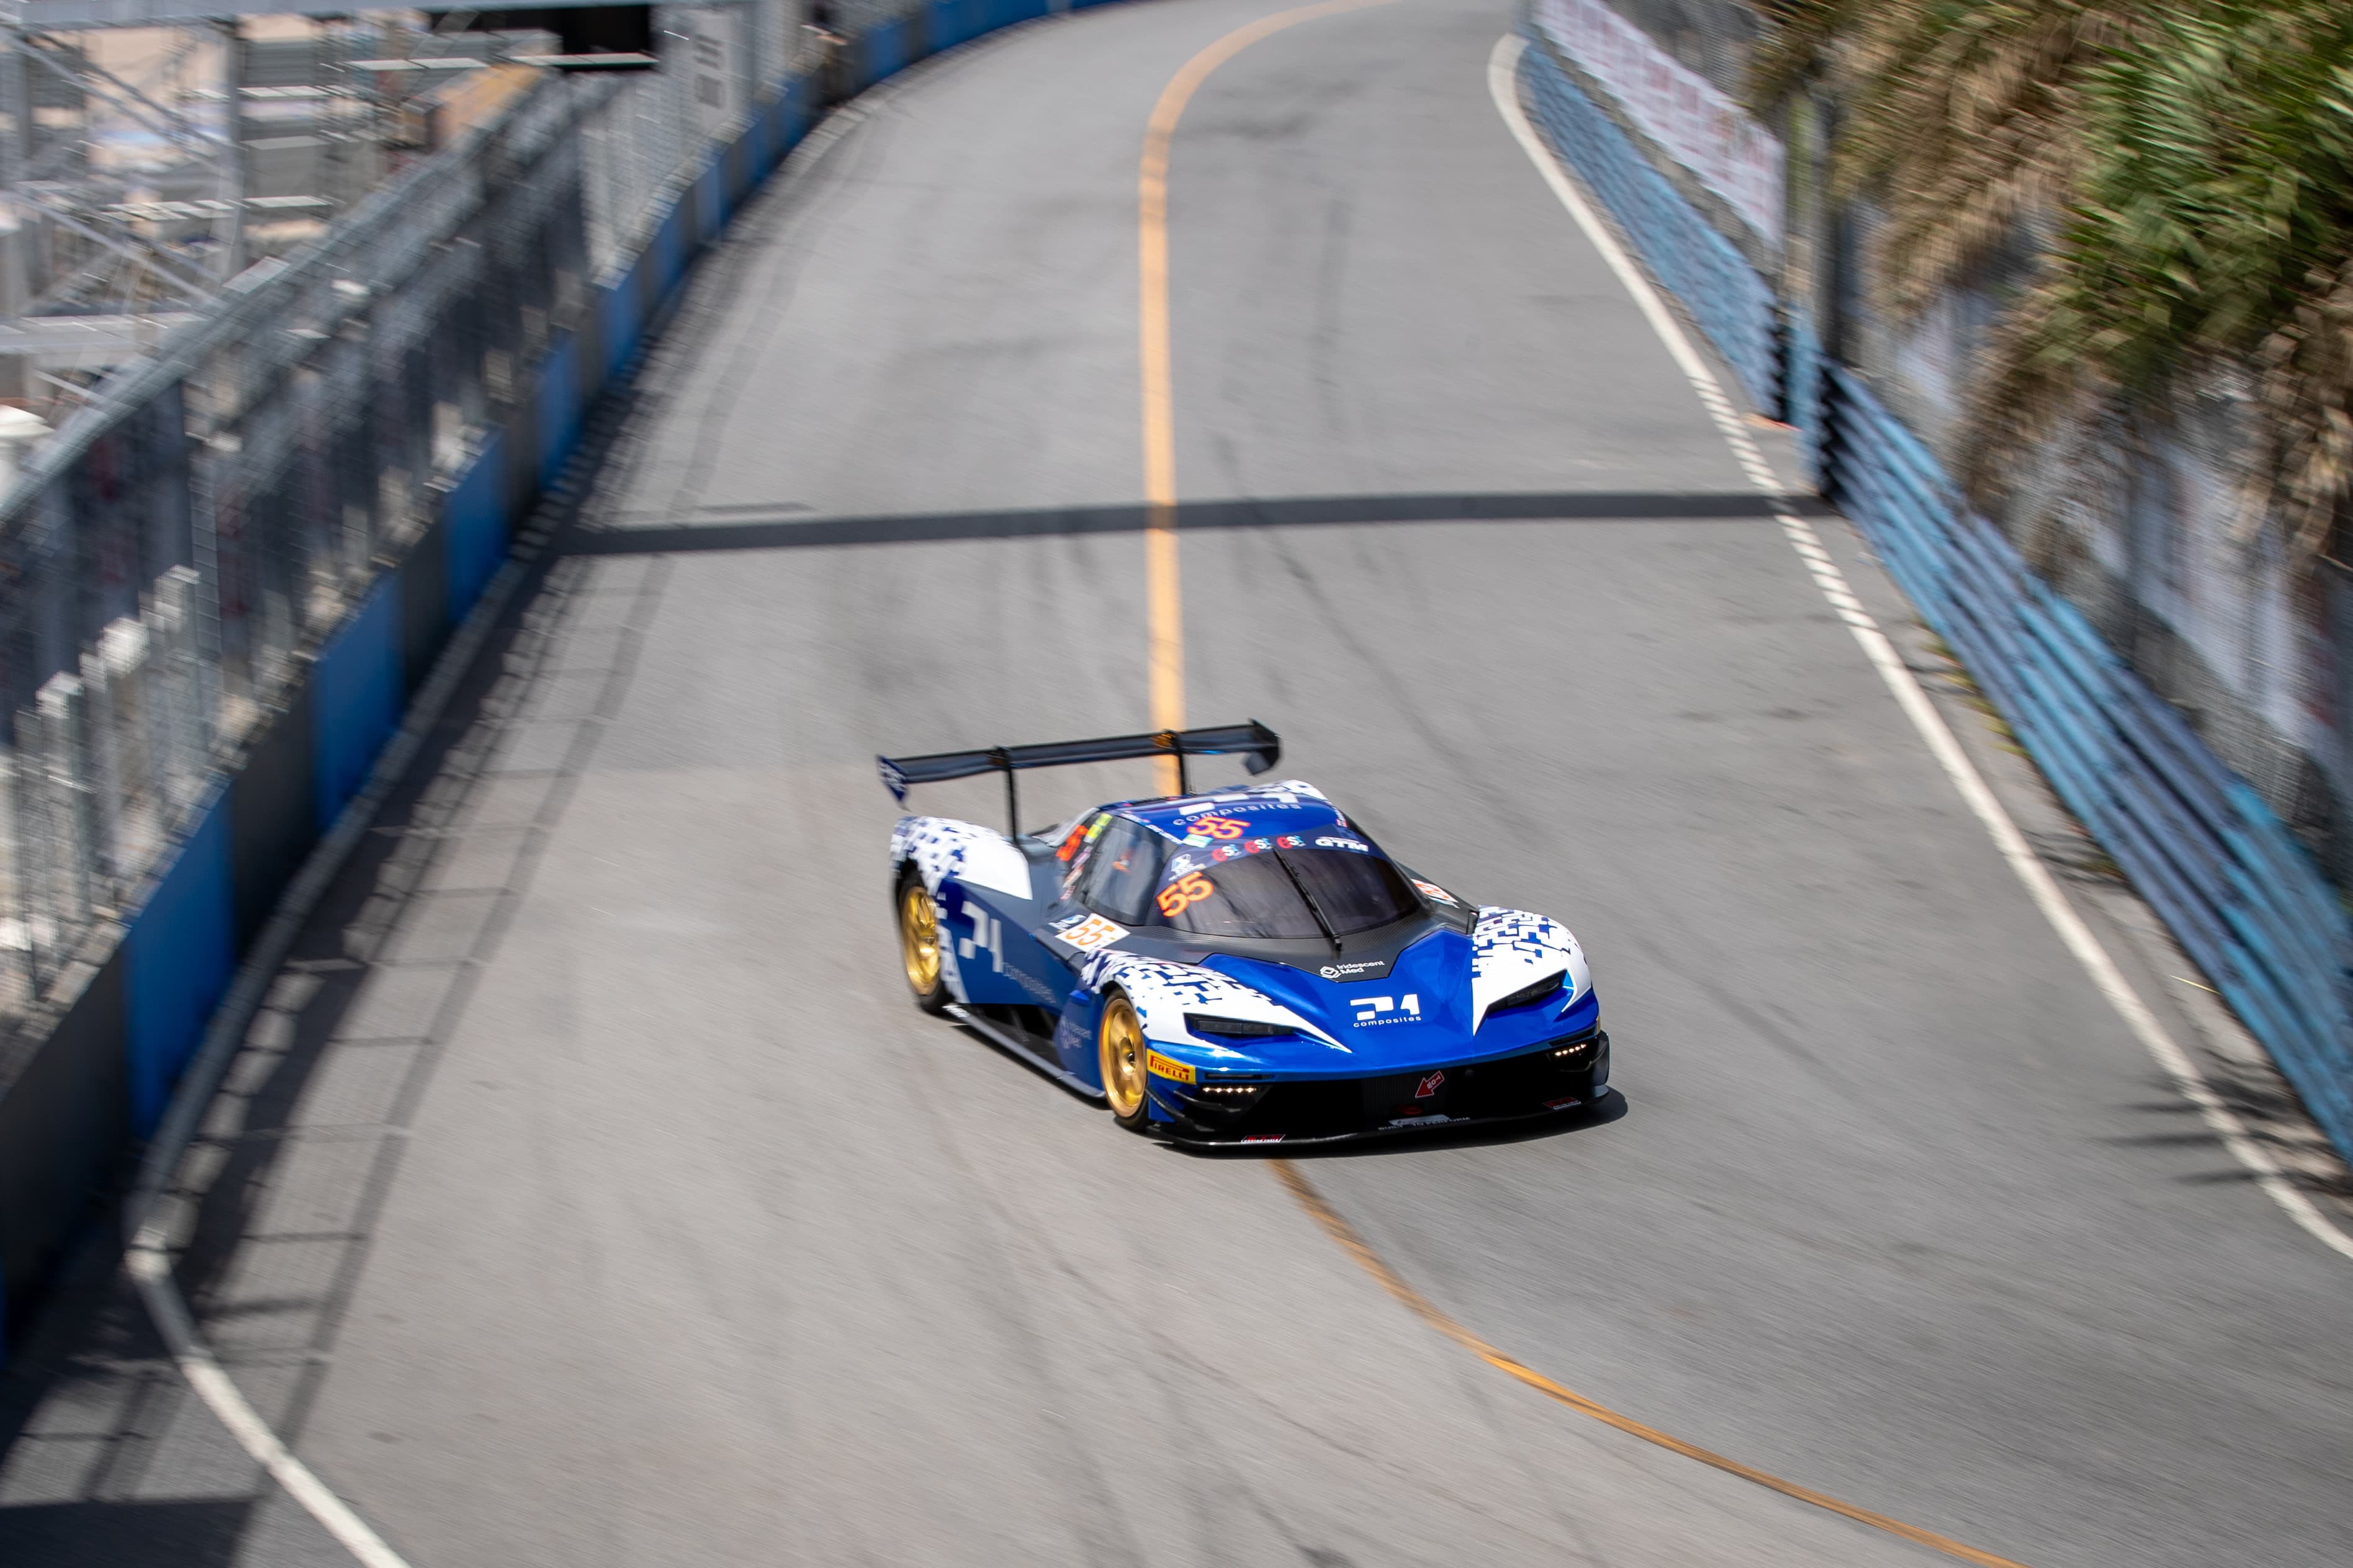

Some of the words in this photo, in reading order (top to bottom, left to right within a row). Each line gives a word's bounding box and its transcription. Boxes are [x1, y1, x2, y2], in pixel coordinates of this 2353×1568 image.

[1186, 817, 1251, 840] 55
[1156, 871, 1213, 917] 55
[1065, 918, 1115, 946] 55
[1336, 961, 1385, 969] Iridescent
[1340, 967, 1364, 975] Med
[1353, 1016, 1422, 1028] composites
[1150, 1054, 1190, 1082] PIRELLI
